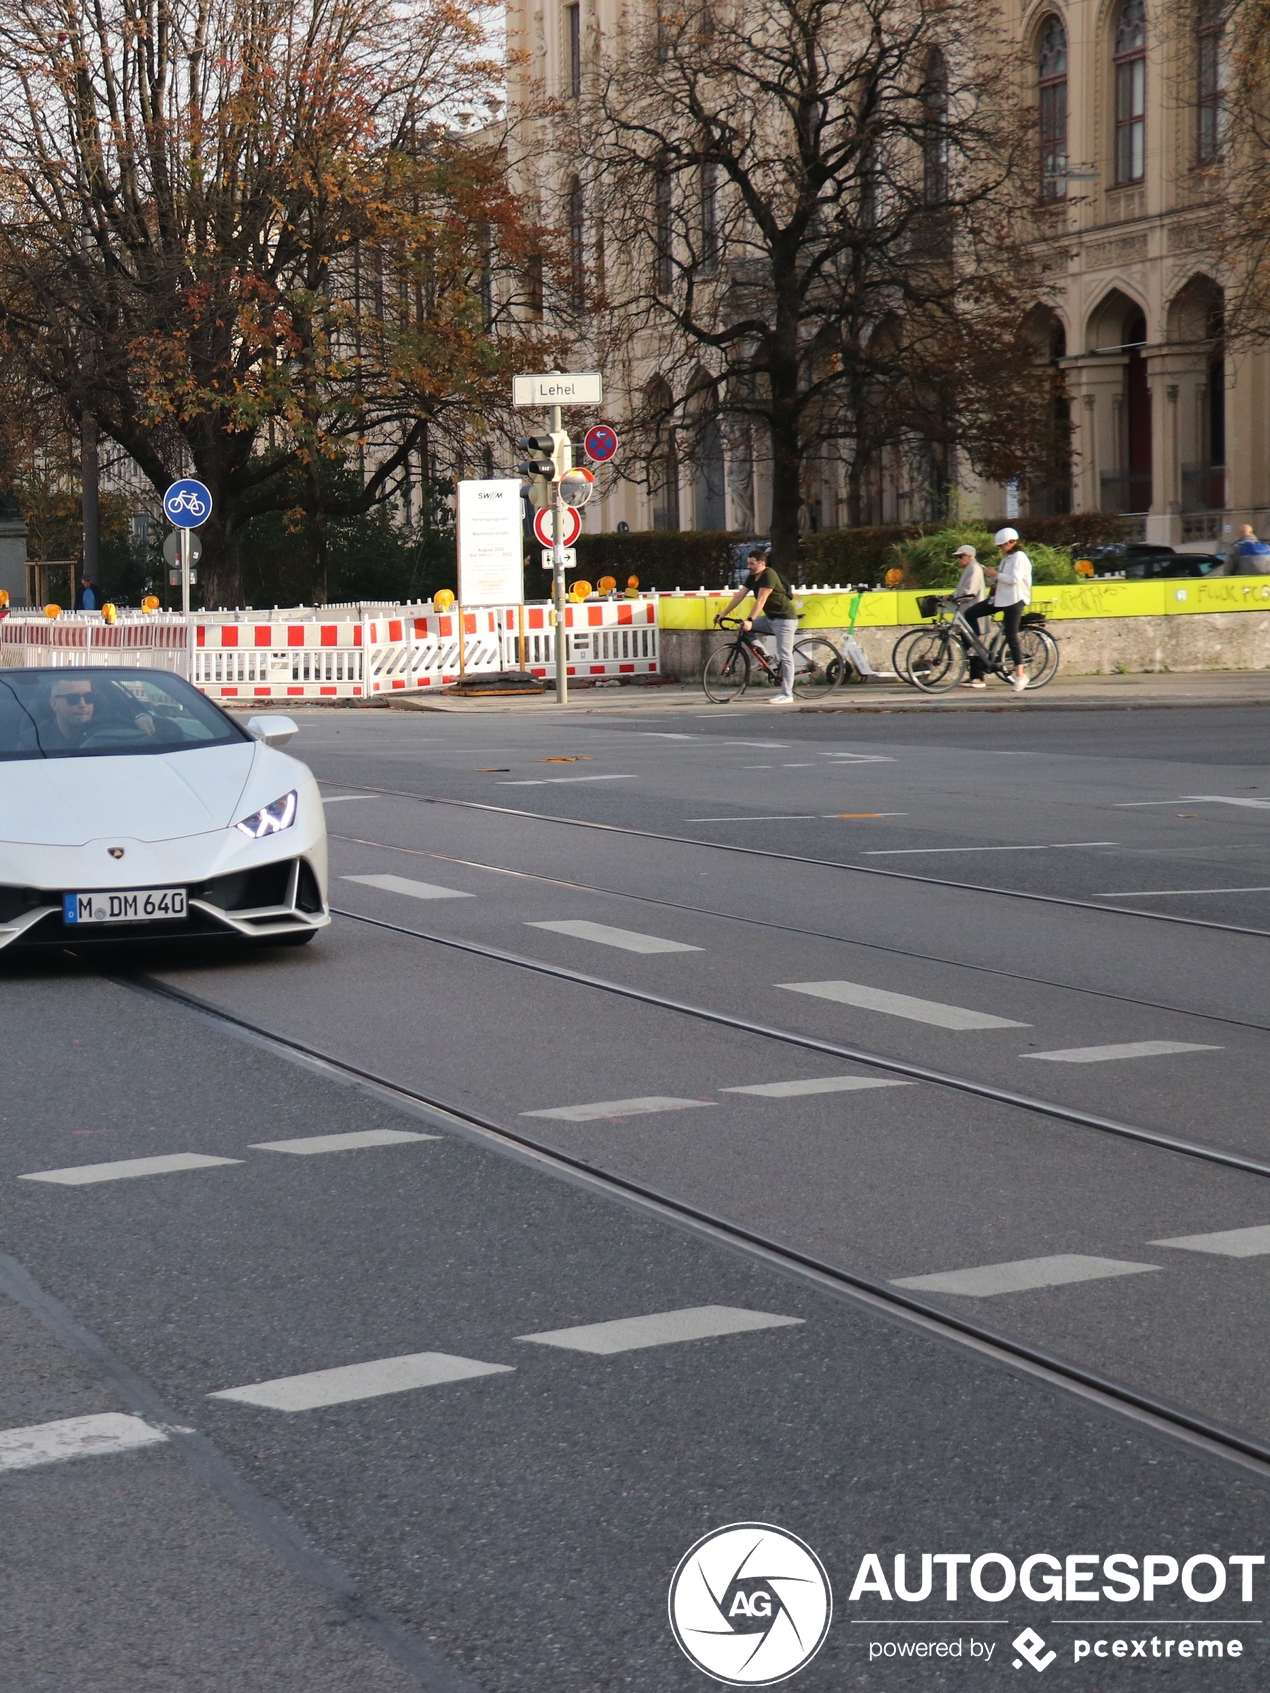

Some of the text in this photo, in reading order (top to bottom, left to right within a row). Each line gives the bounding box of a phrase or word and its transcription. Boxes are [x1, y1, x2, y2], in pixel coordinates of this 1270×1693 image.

[540, 383, 576, 396] Lehel
[78, 897, 92, 918] M
[108, 895, 138, 917] DM
[143, 892, 185, 915] 640
